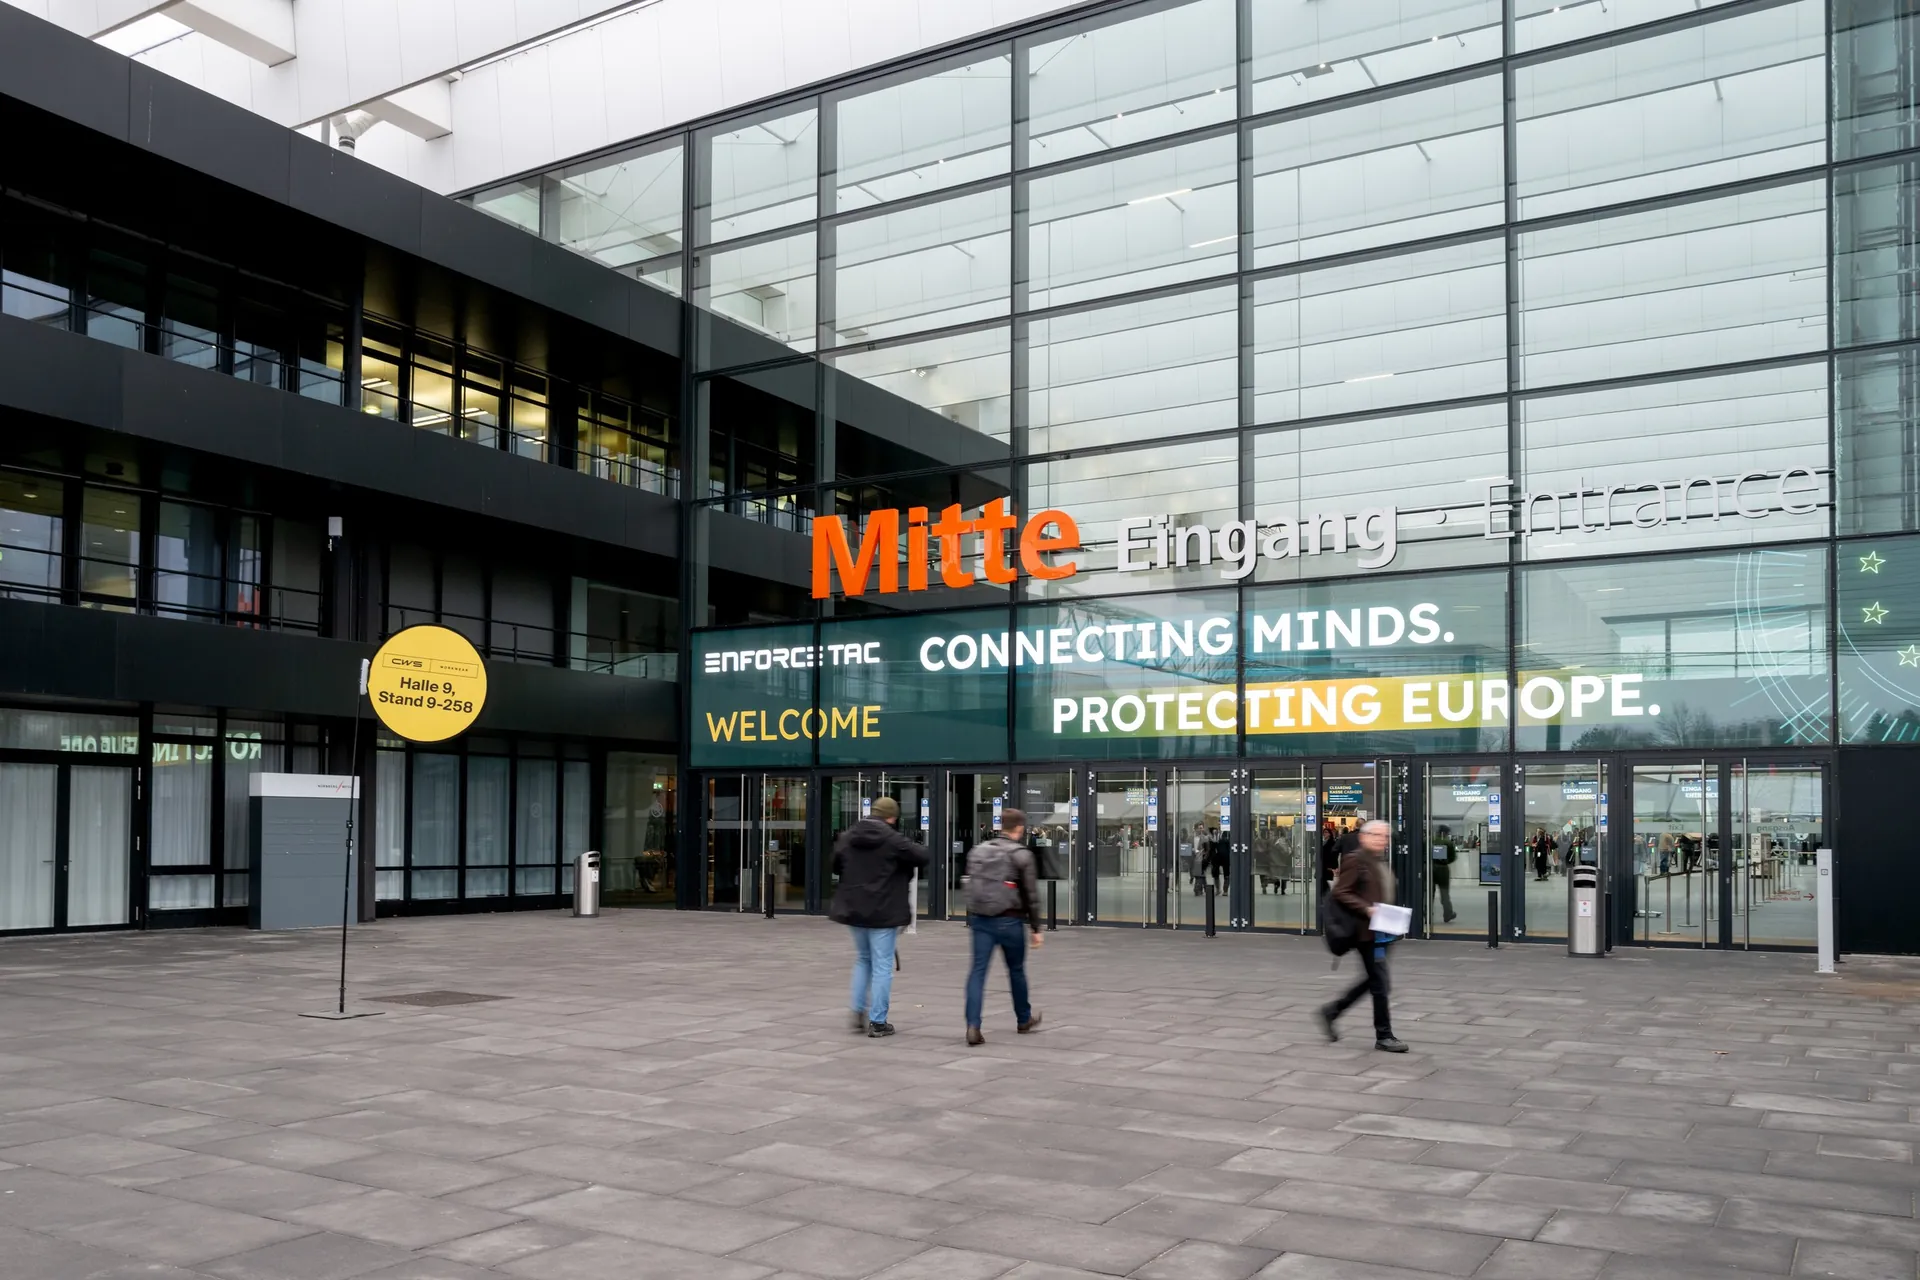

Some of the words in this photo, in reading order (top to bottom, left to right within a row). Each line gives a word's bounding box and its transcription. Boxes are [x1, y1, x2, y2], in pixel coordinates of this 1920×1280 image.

[811, 497, 1080, 599] Mitte
[1117, 506, 1397, 579] Eingang
[1484, 466, 1819, 541] Entrance
[920, 617, 1234, 671] CONNECTING
[1253, 603, 1455, 653] MINDS.
[391, 657, 423, 668] CWS
[705, 646, 823, 673] ENFORCE
[827, 642, 880, 665] TAC
[378, 691, 424, 708] Stand
[426, 696, 473, 714] 9-258
[400, 676, 439, 693] Halle
[442, 682, 456, 697] 9,
[1053, 684, 1382, 733] PROTECTING
[1403, 673, 1661, 724] EUROPE.
[706, 705, 881, 743] WELCOME
